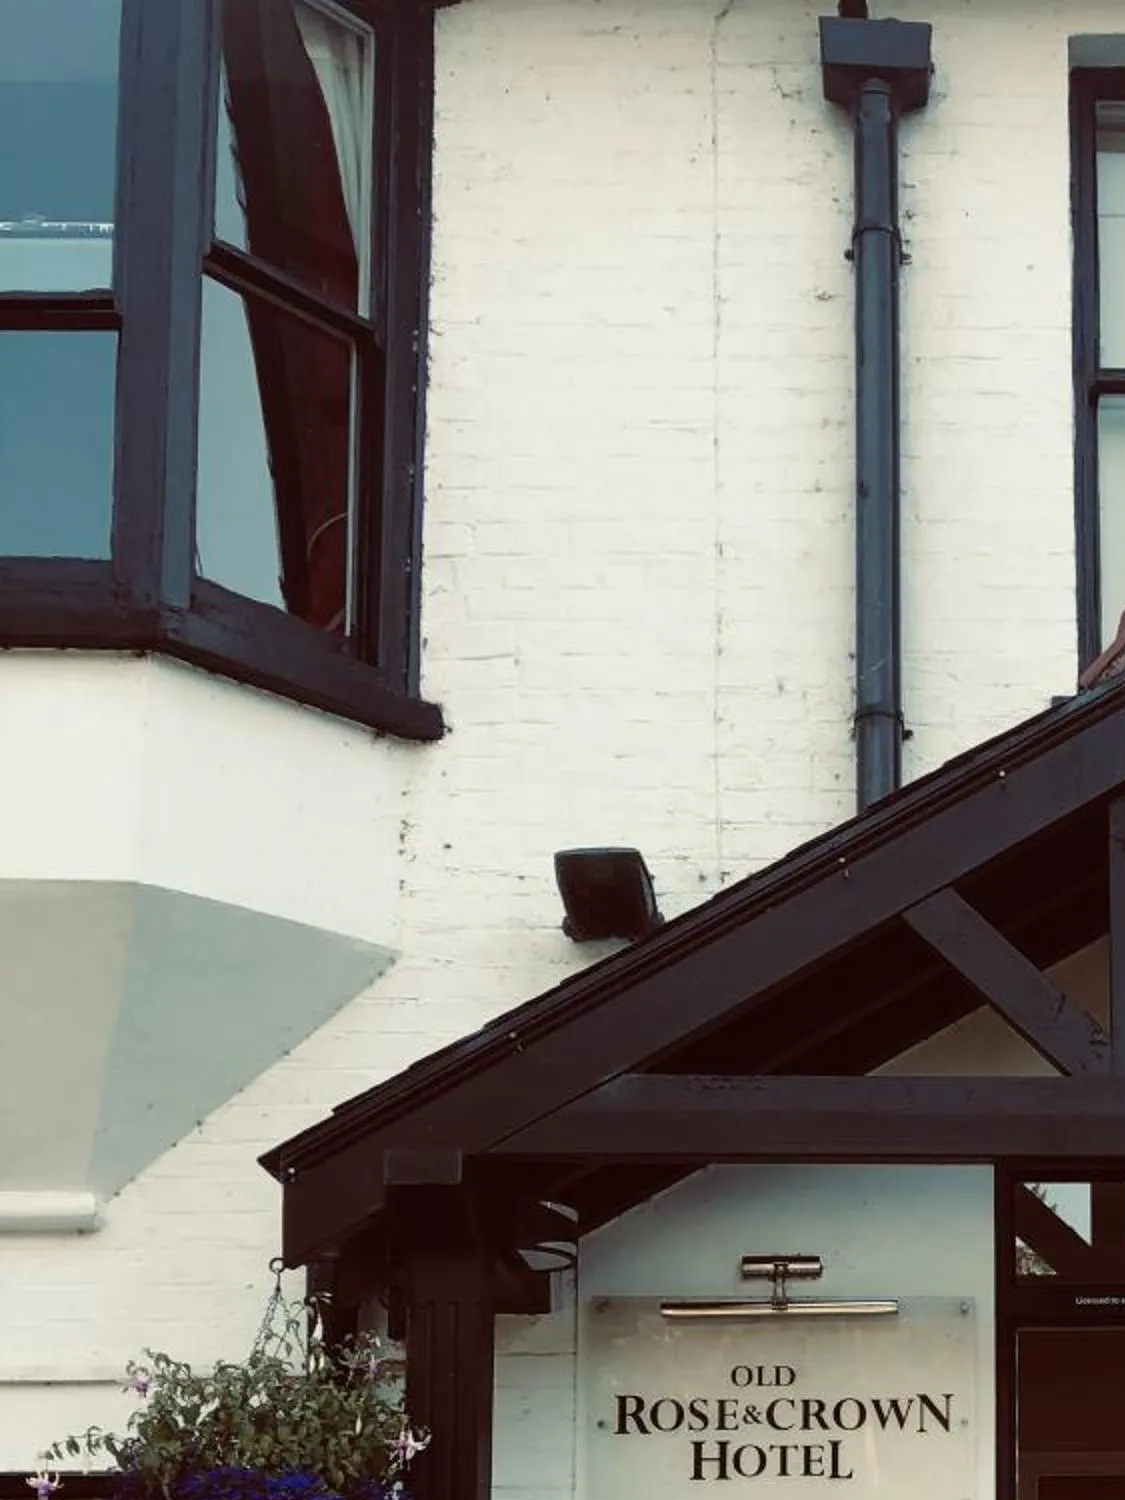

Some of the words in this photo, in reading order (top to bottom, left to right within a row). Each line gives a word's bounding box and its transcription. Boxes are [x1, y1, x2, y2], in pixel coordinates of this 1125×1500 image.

[731, 1365, 796, 1387] OLD
[614, 1393, 955, 1435] ROSE&CROWN
[690, 1440, 853, 1480] HOTEL
